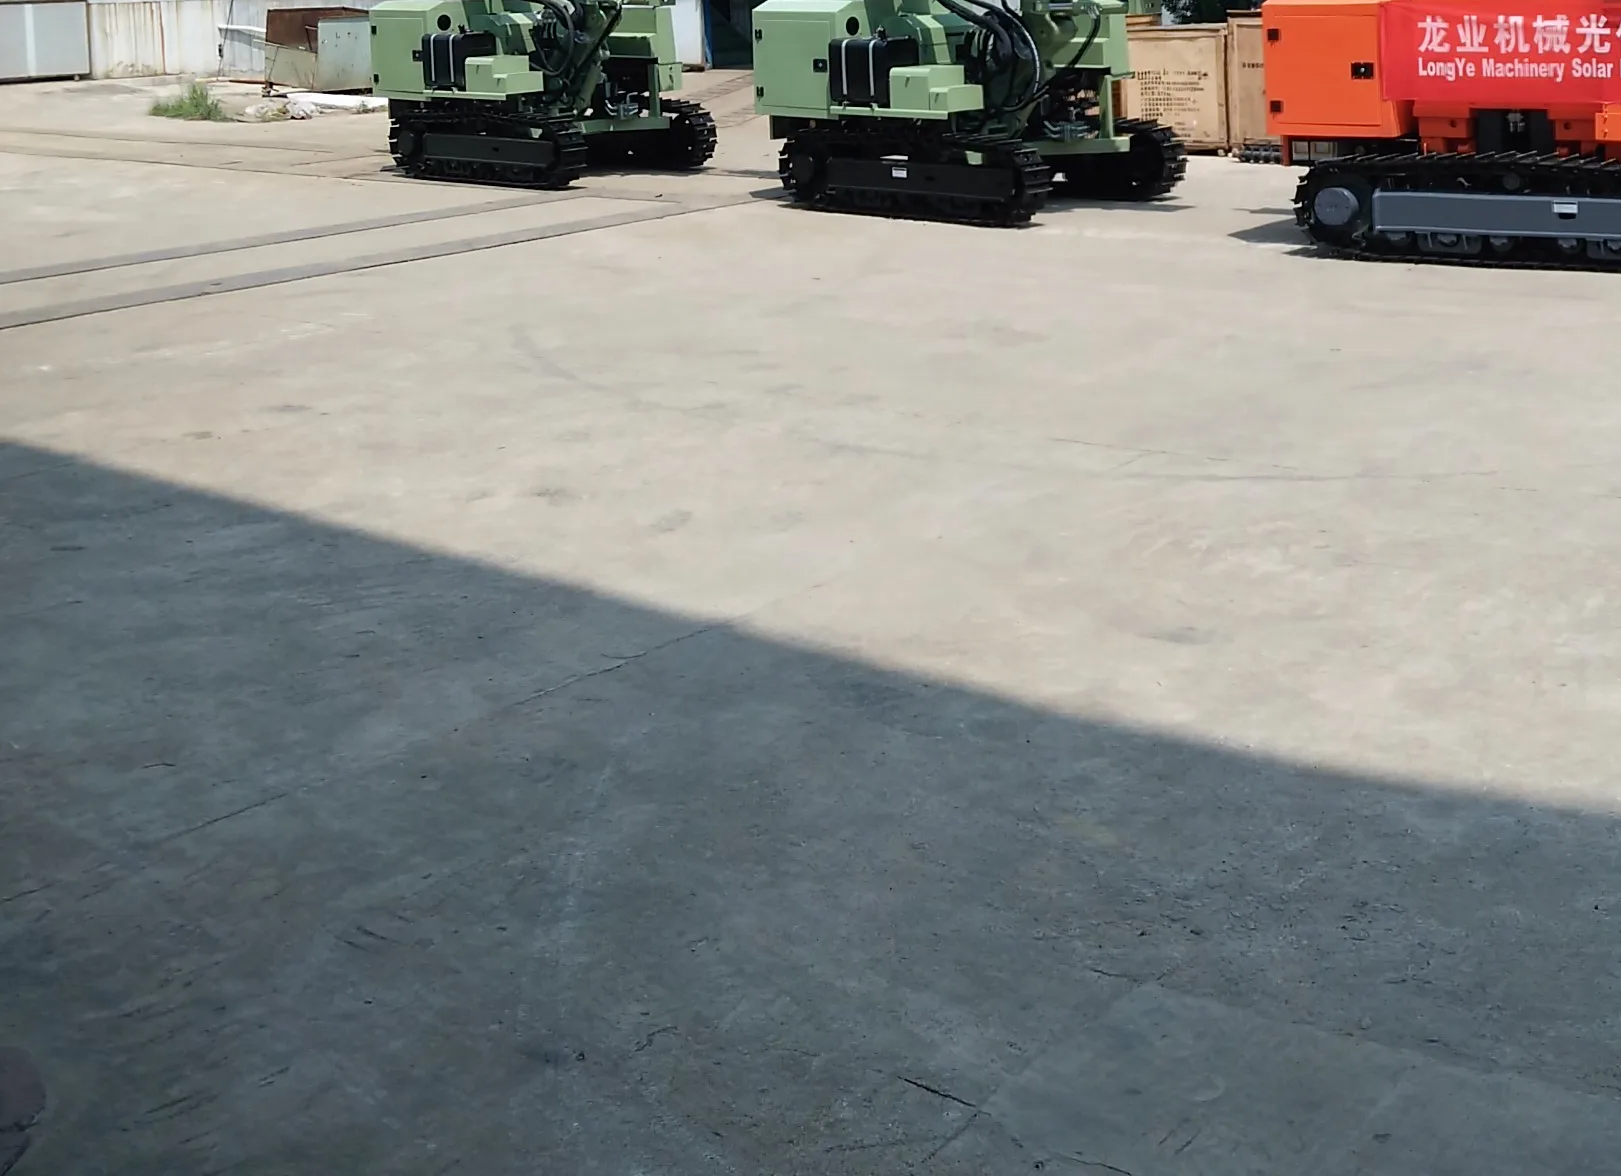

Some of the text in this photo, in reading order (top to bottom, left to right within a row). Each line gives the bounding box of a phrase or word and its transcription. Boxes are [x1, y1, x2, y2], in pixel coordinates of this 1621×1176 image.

[1418, 57, 1476, 81] LongYe
[1481, 57, 1565, 83] Machinery
[1571, 57, 1614, 79] Solar
